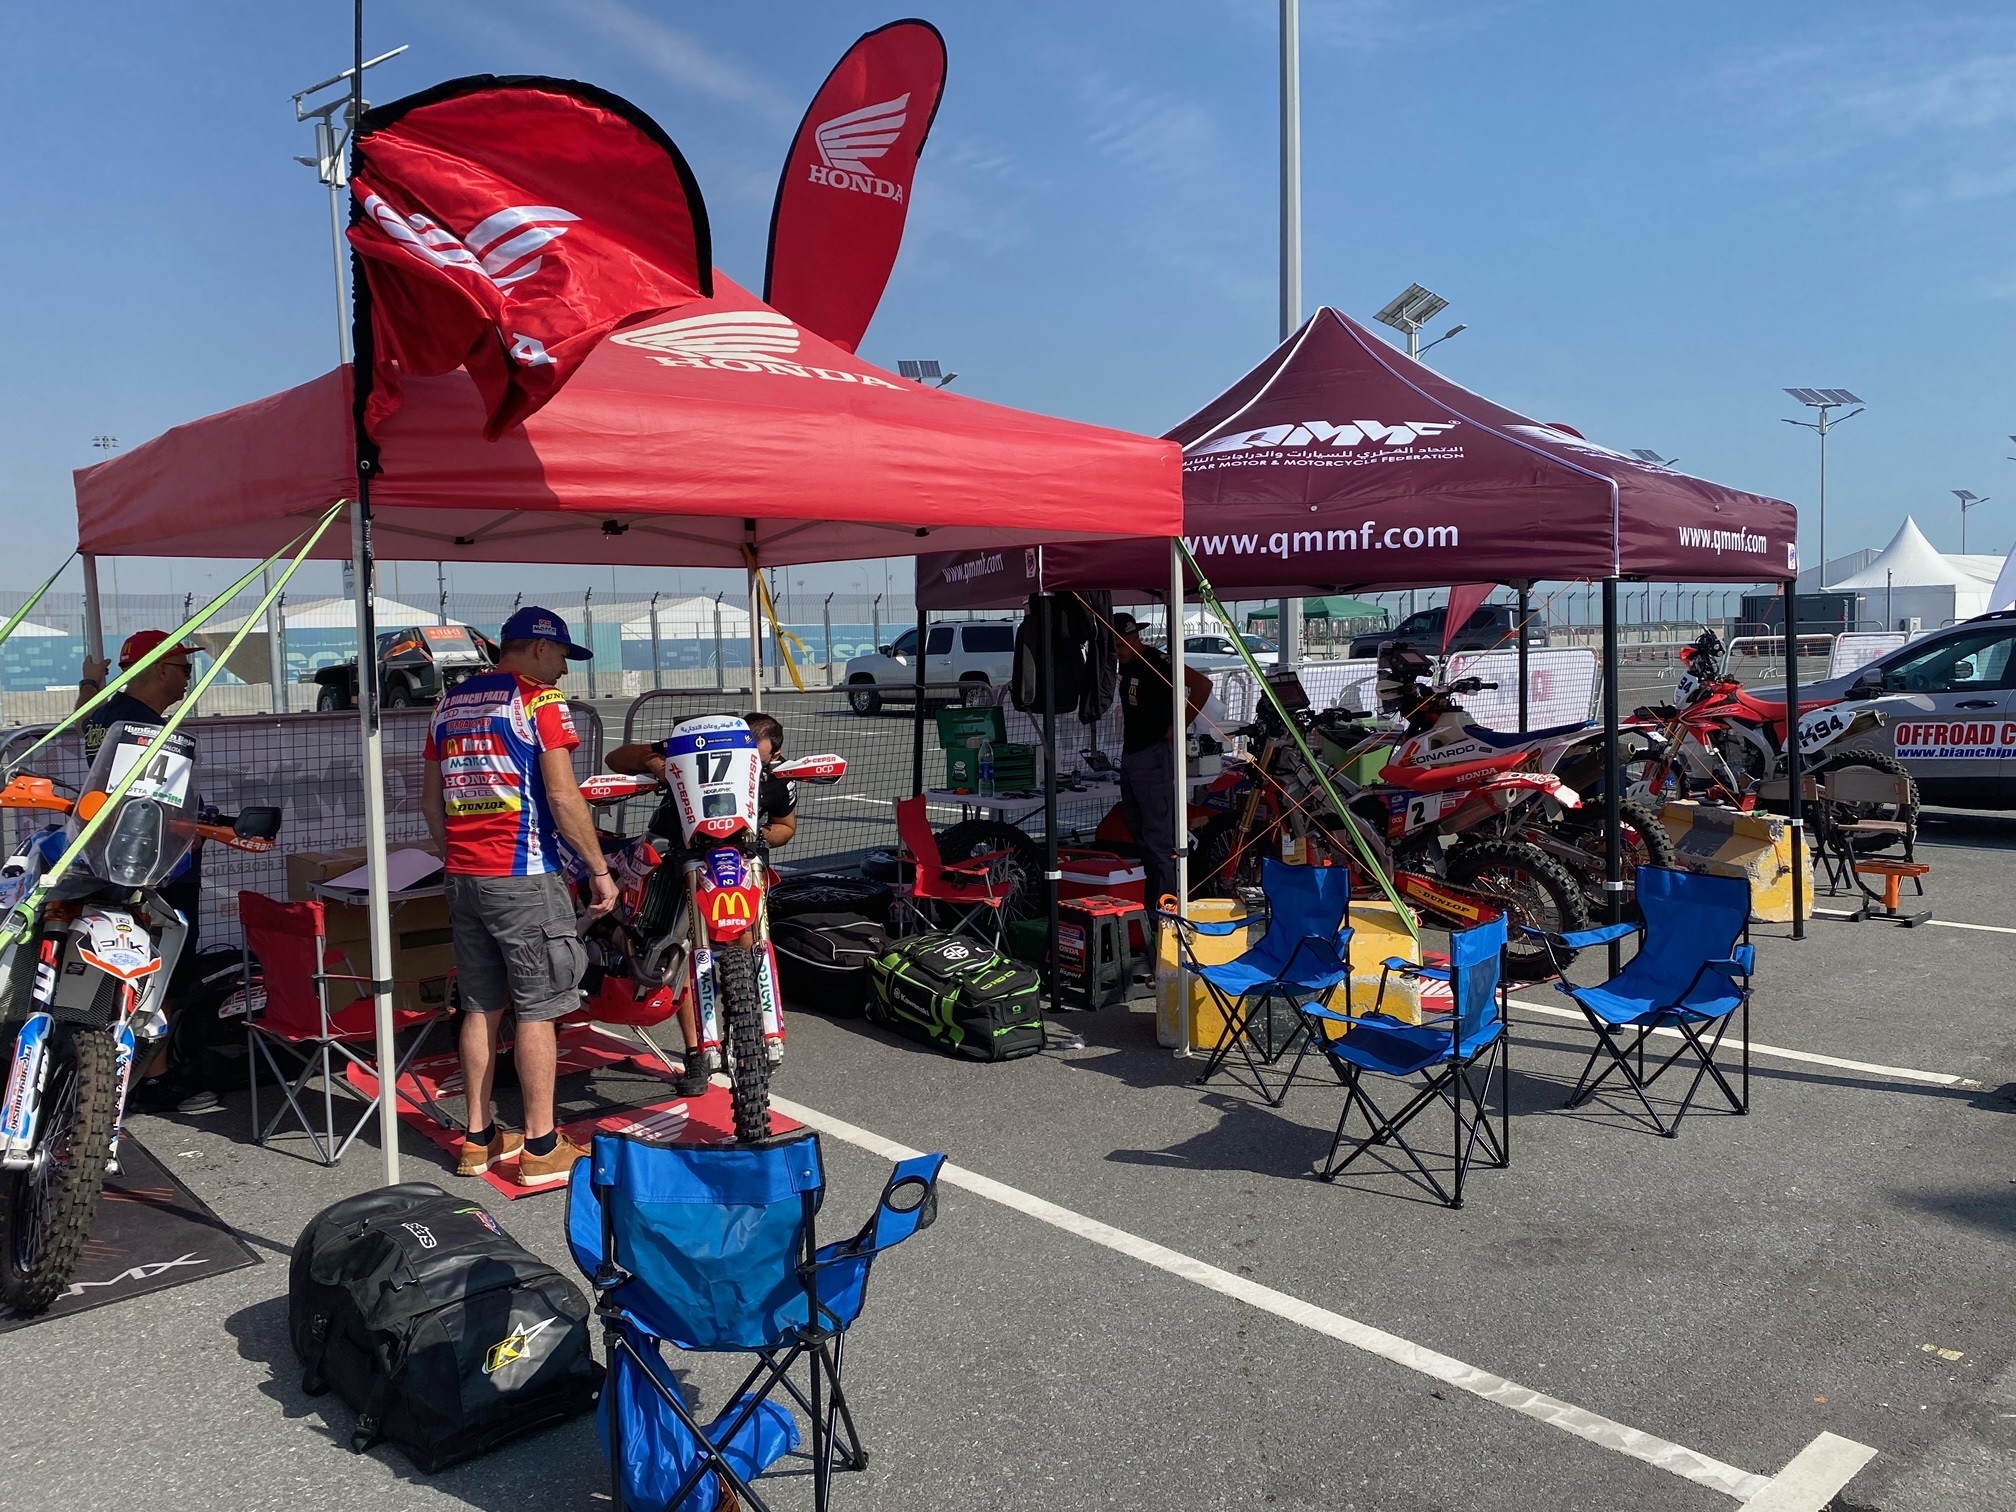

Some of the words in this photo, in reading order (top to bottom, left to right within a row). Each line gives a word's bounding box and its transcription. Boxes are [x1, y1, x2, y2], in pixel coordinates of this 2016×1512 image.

[808, 163, 904, 204] HONDA
[645, 353, 909, 392] HONDA
[1183, 463, 1215, 472] ATAR
[1219, 459, 1267, 468] MOTOR
[1381, 453, 1465, 463] FEDERATION
[1183, 520, 1459, 560] www.qmmf.com
[1678, 525, 1767, 556] www.qmmf.com
[941, 551, 1004, 584] www.qmmf.com
[1678, 676, 1694, 694] 94
[513, 699, 525, 728] CEPSA
[1897, 723, 1996, 746] OFFROAD
[696, 750, 733, 785] 17
[815, 764, 834, 774] acp
[1456, 767, 1498, 784] HONDA
[444, 773, 505, 787] HONDA
[590, 786, 612, 796] acp
[457, 801, 507, 812] DUNLOP
[676, 781, 696, 825] CEPSA
[1411, 801, 1426, 826] 2
[707, 818, 735, 831] acp
[1422, 891, 1471, 912] DUNLOP
[717, 918, 747, 928] Marco
[1058, 945, 1080, 956] ONDA
